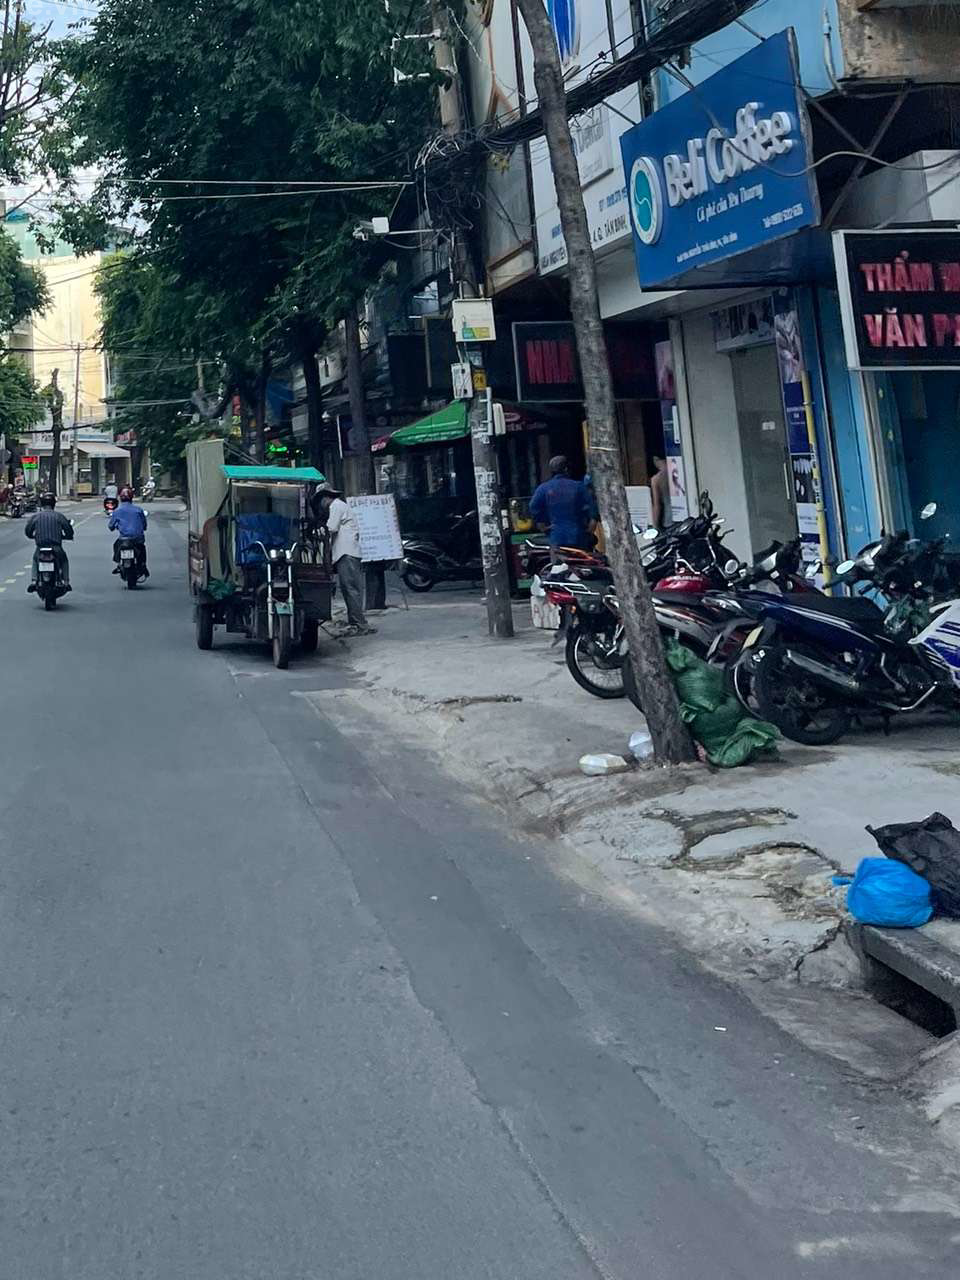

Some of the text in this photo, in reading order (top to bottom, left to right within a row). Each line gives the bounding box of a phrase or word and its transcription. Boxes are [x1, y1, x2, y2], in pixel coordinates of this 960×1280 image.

[663, 138, 709, 208] Beli
[706, 101, 794, 185] Coffee
[864, 307, 927, 347] VĂN
